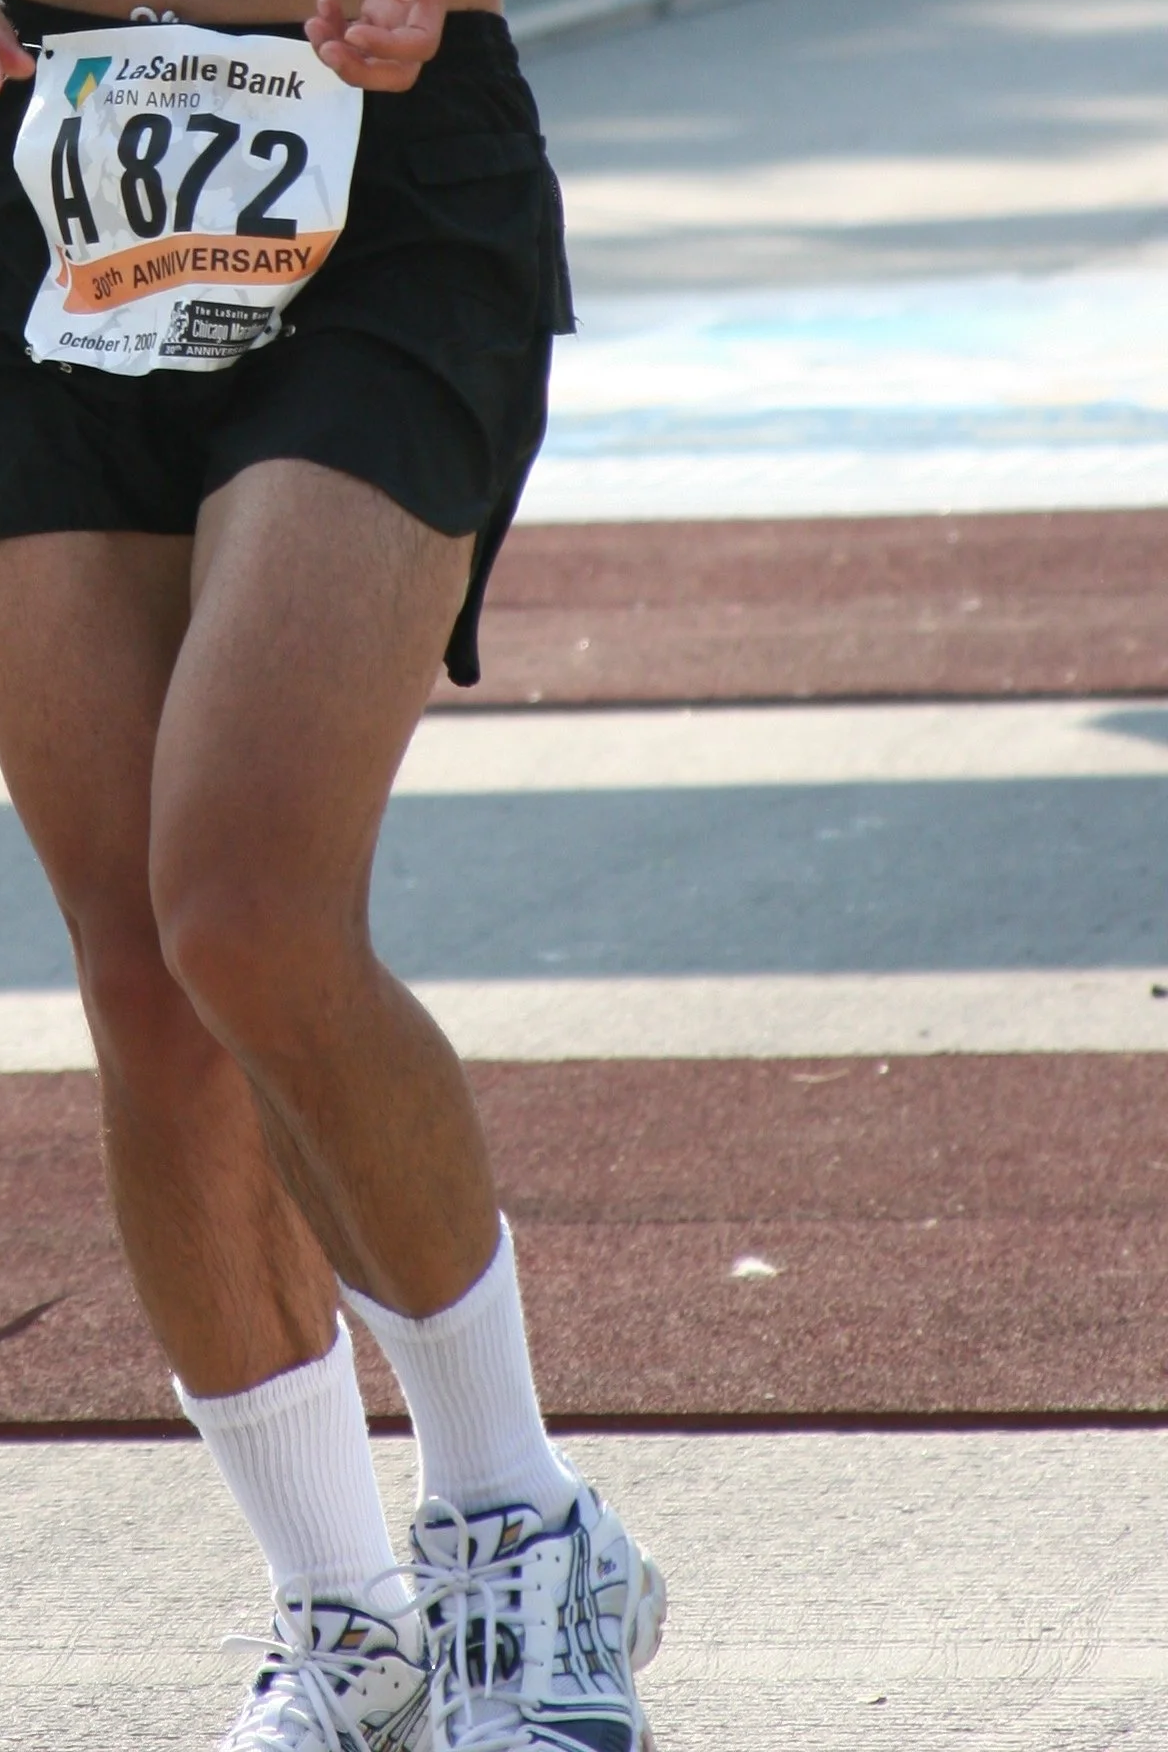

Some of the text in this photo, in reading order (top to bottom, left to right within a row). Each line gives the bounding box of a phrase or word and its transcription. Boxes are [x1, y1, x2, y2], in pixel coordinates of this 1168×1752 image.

[116, 55, 306, 100] LaSalle Bank
[104, 89, 201, 108] ABN AMRO
[51, 112, 309, 246] A 872
[92, 246, 312, 301] 30th ANNIVERSARY
[195, 306, 211, 317] The
[215, 309, 249, 321] LaSalle
[59, 331, 158, 355] October 7, 2007
[192, 319, 229, 344] Chicago
